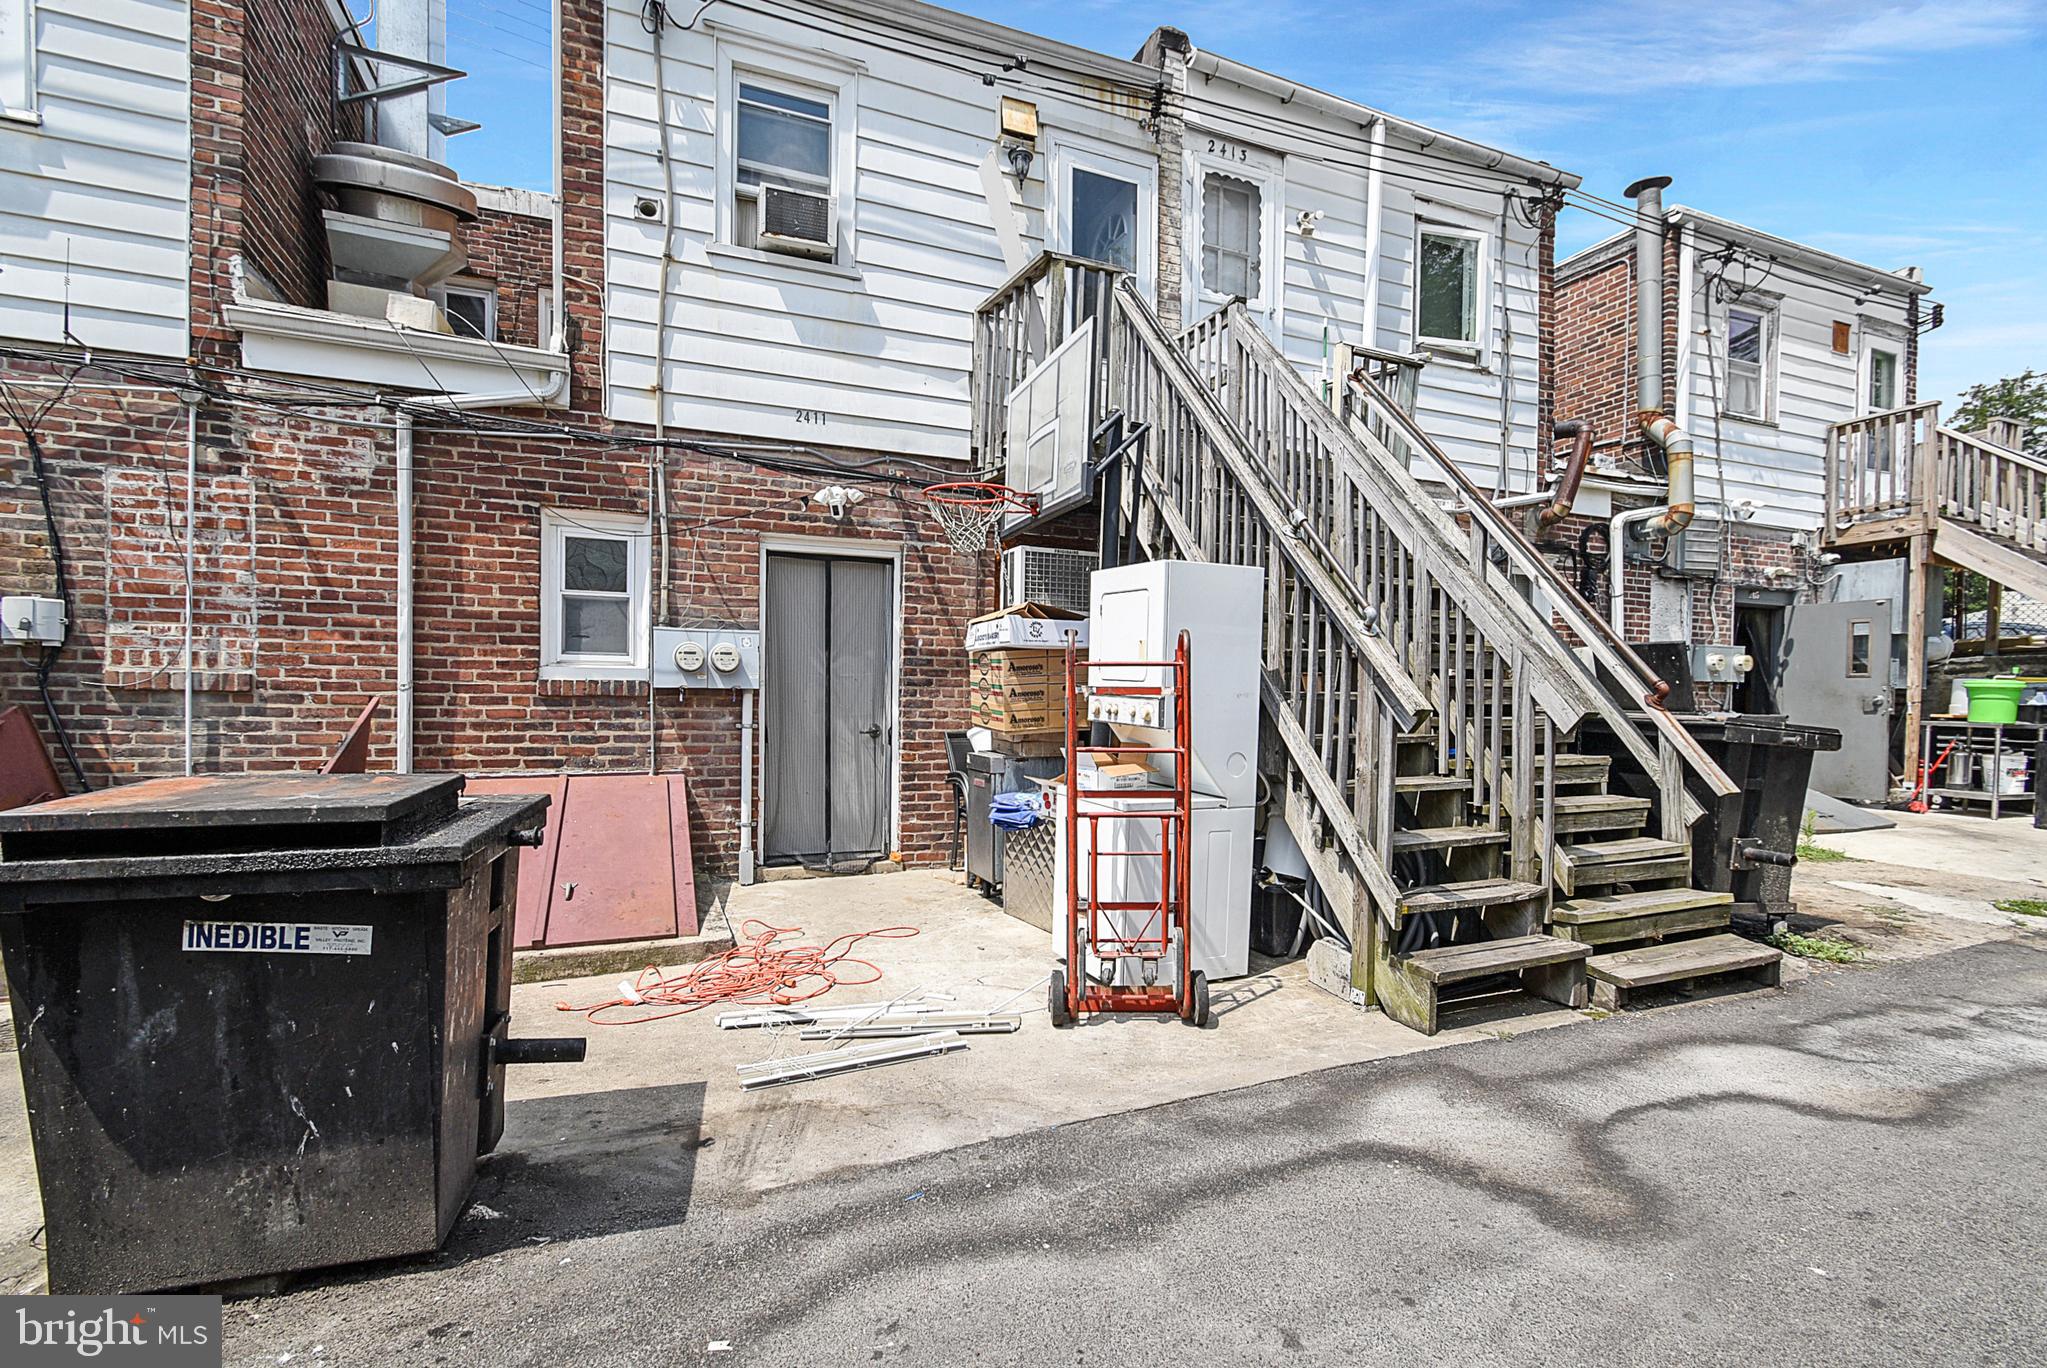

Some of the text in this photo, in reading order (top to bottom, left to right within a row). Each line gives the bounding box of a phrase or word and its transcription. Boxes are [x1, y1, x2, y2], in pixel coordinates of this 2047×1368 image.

[1208, 139, 1247, 161] 2413
[796, 410, 826, 426] 2411
[187, 923, 311, 950] INEDIBLE
